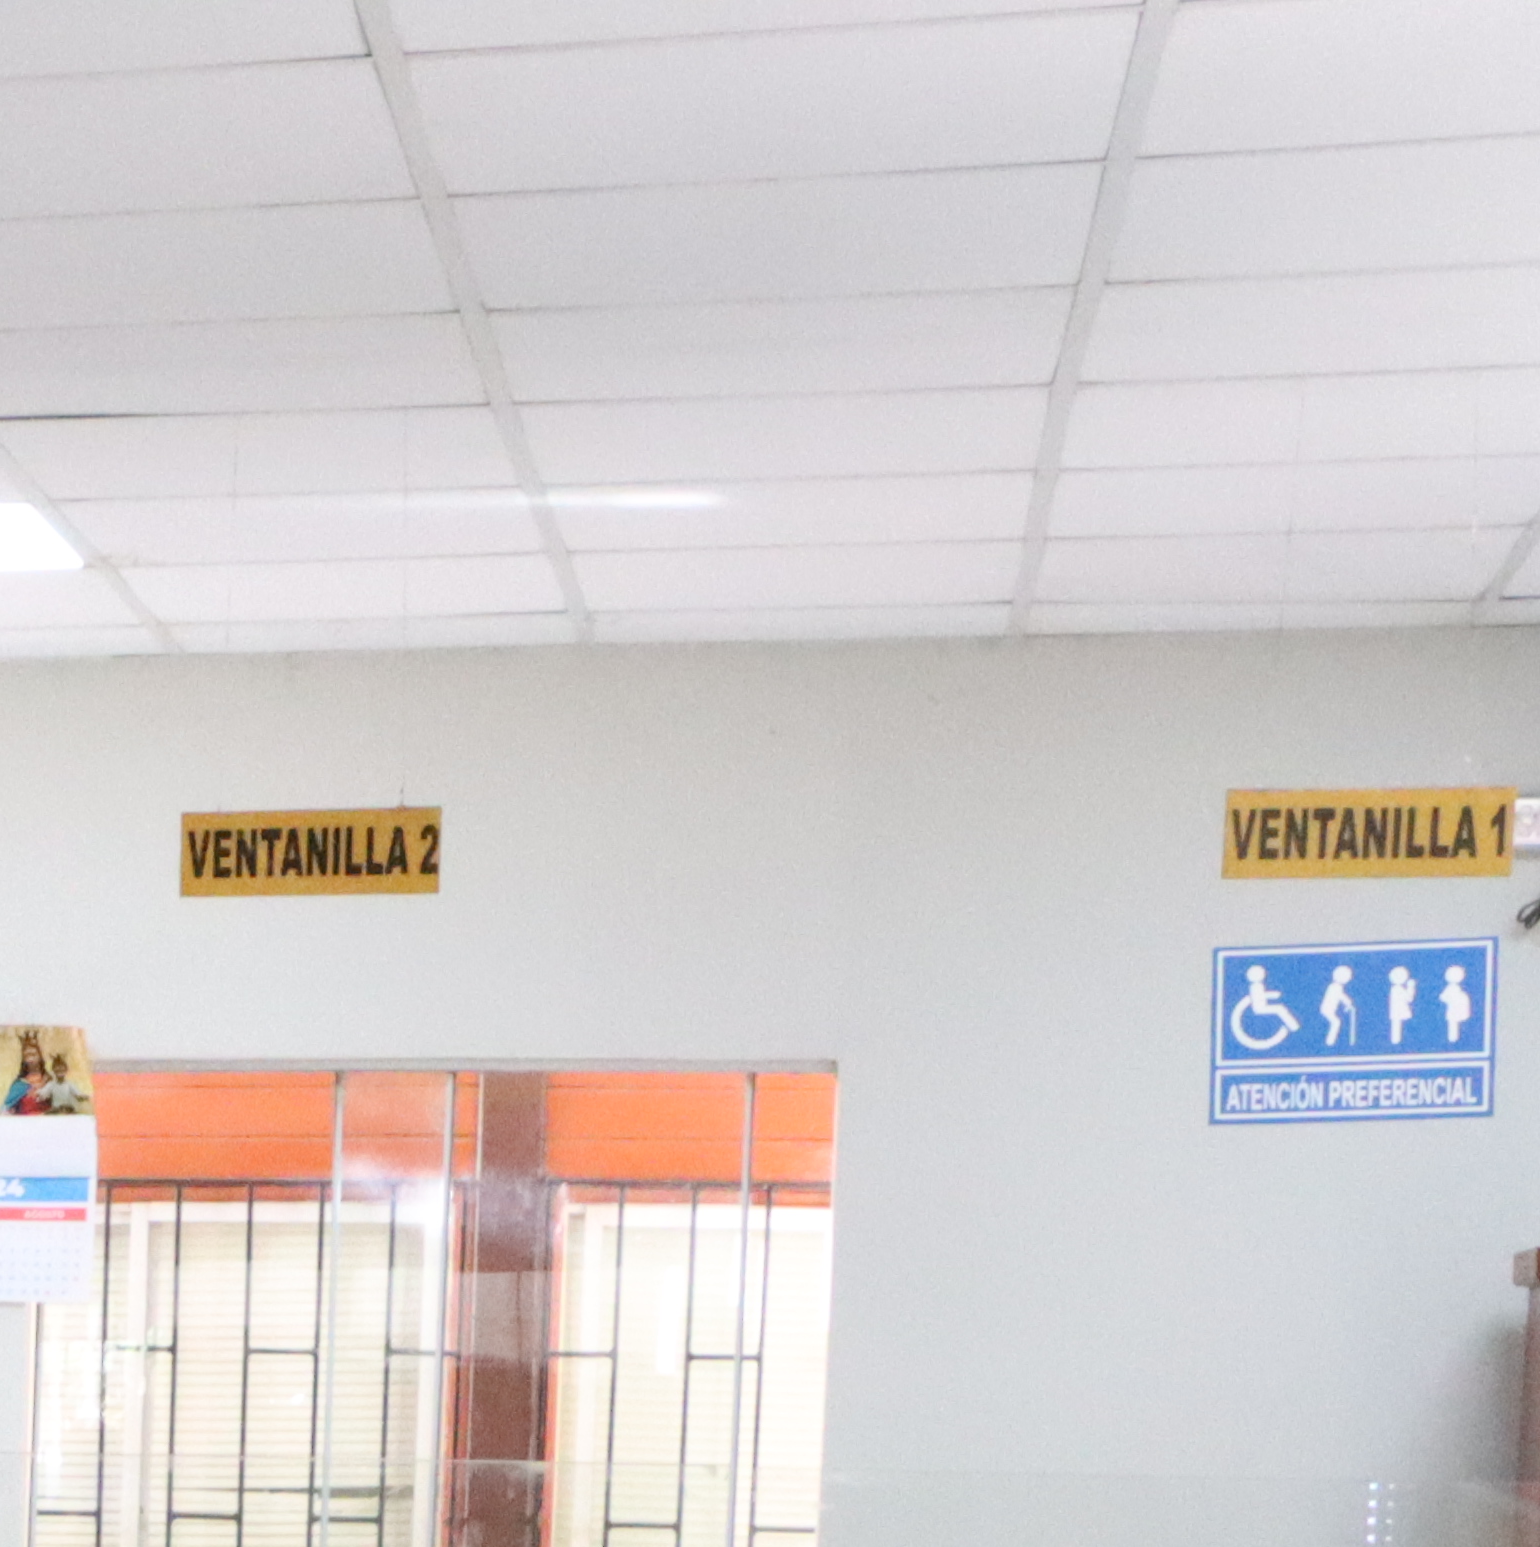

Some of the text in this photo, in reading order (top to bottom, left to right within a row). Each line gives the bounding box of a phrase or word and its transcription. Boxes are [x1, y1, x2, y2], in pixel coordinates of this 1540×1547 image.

[188, 824, 439, 878] VENTANILLA 2
[1232, 804, 1507, 860] VENTANILLA 1
[1226, 1075, 1478, 1111] ATENCIÓN PREFERENCIAL
